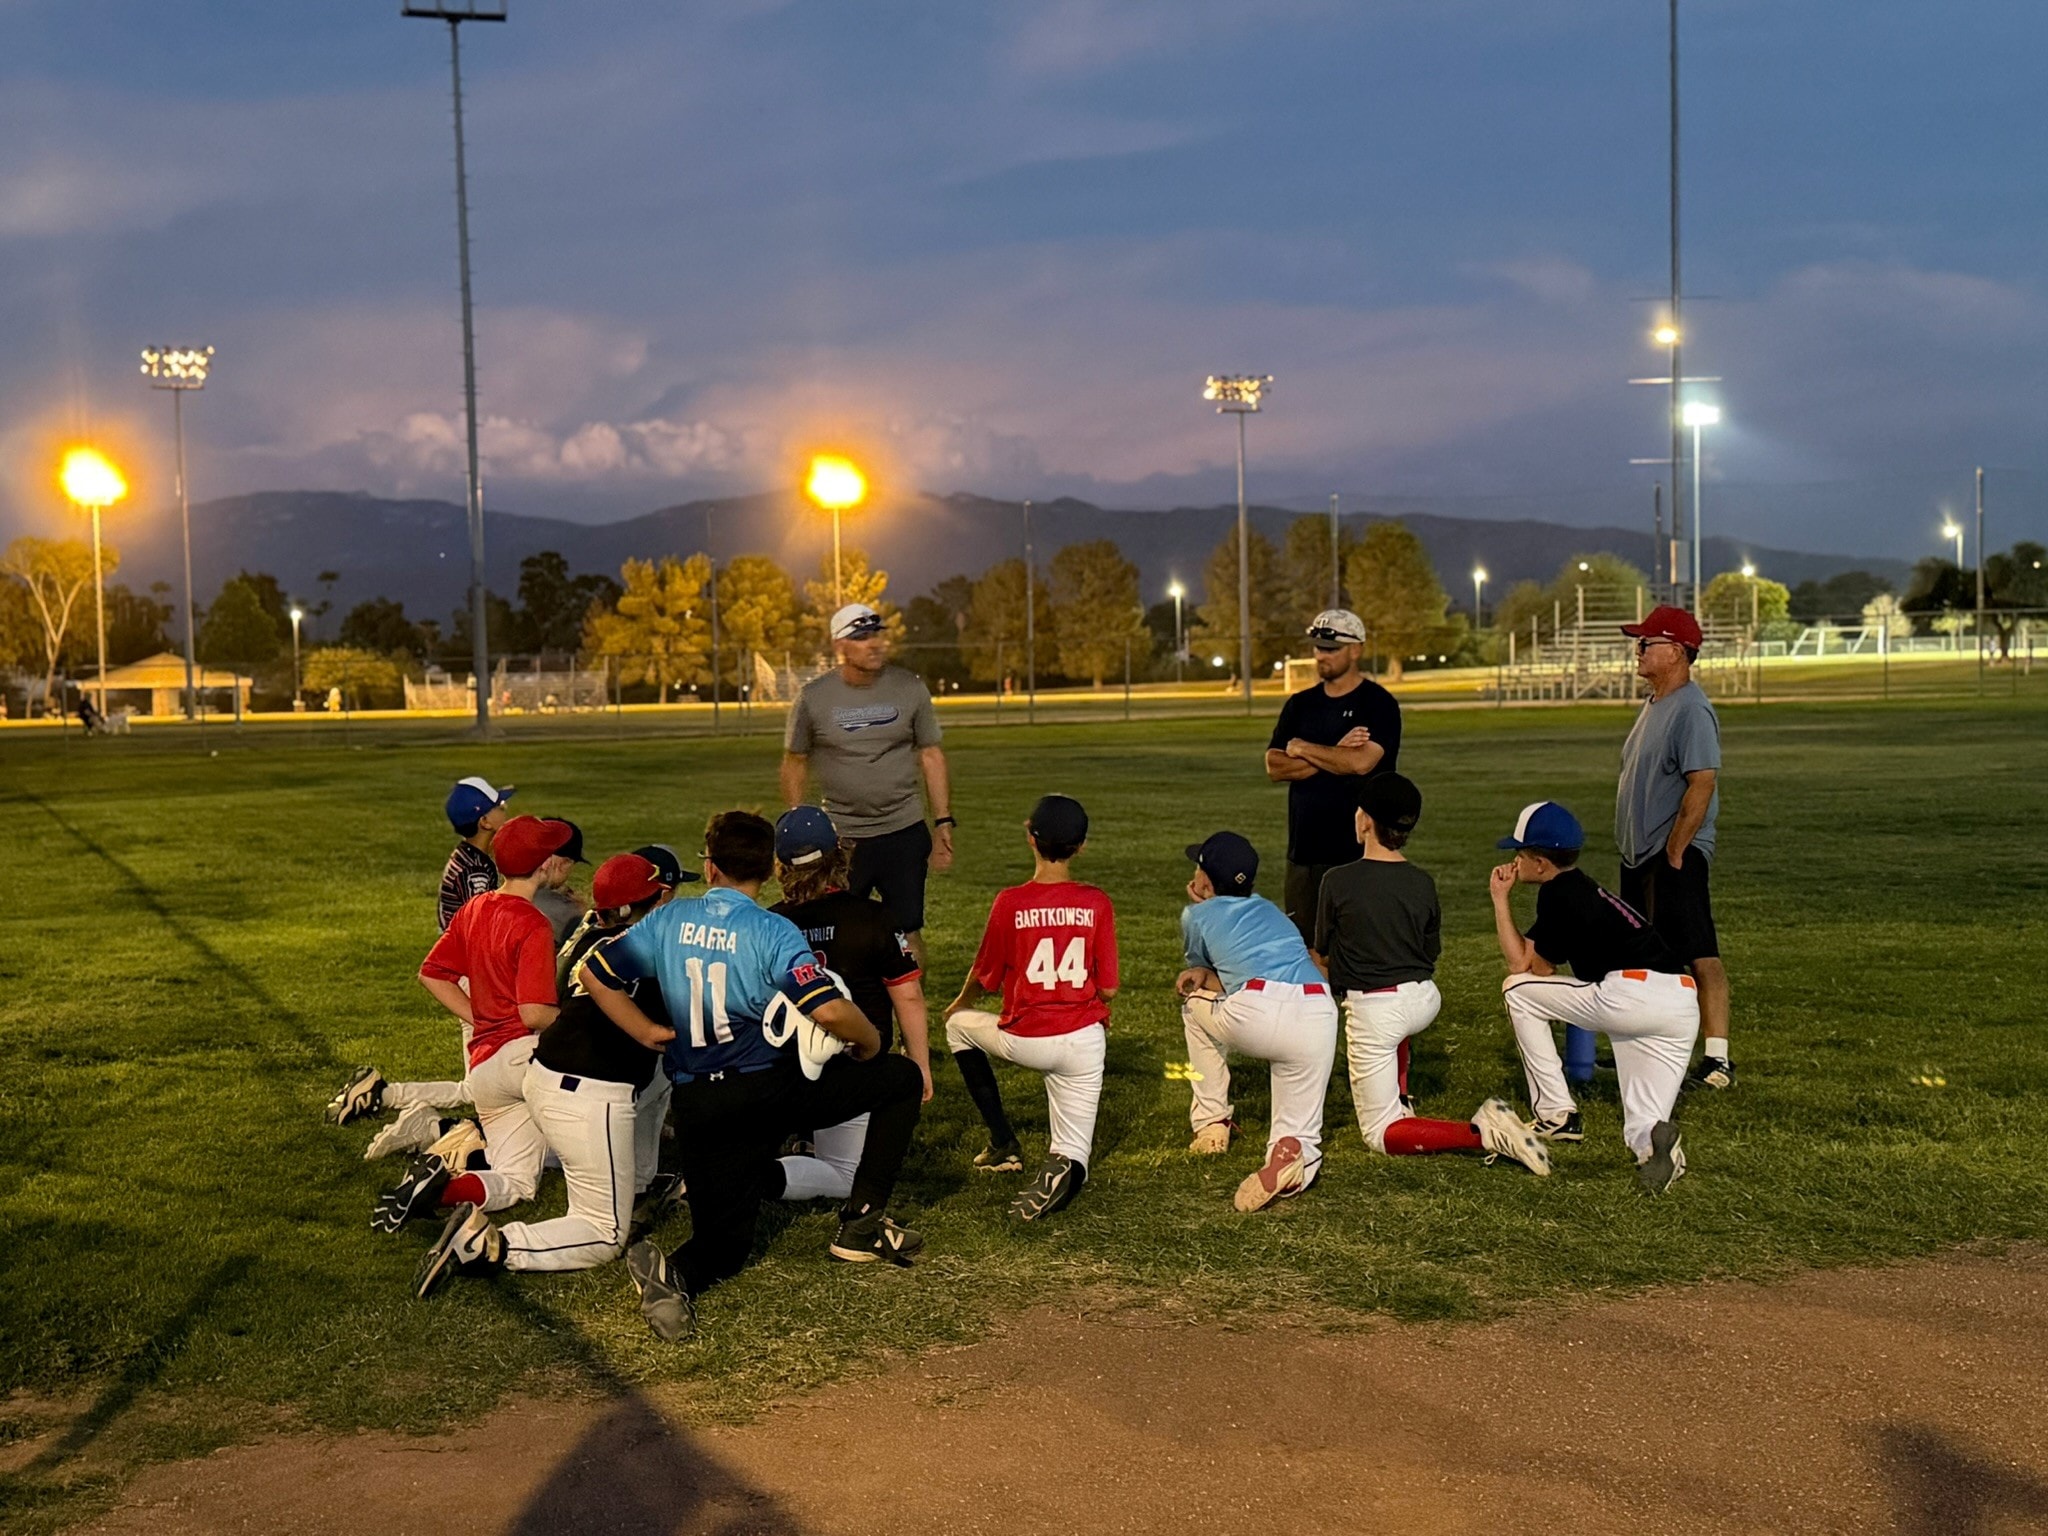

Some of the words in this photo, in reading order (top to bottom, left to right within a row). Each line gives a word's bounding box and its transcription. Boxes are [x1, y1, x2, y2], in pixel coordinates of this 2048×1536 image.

[678, 922, 737, 954] IBARRA
[1015, 907, 1094, 930] BARTKOWSKI
[1025, 936, 1088, 991] 44
[685, 957, 734, 1047] 11
